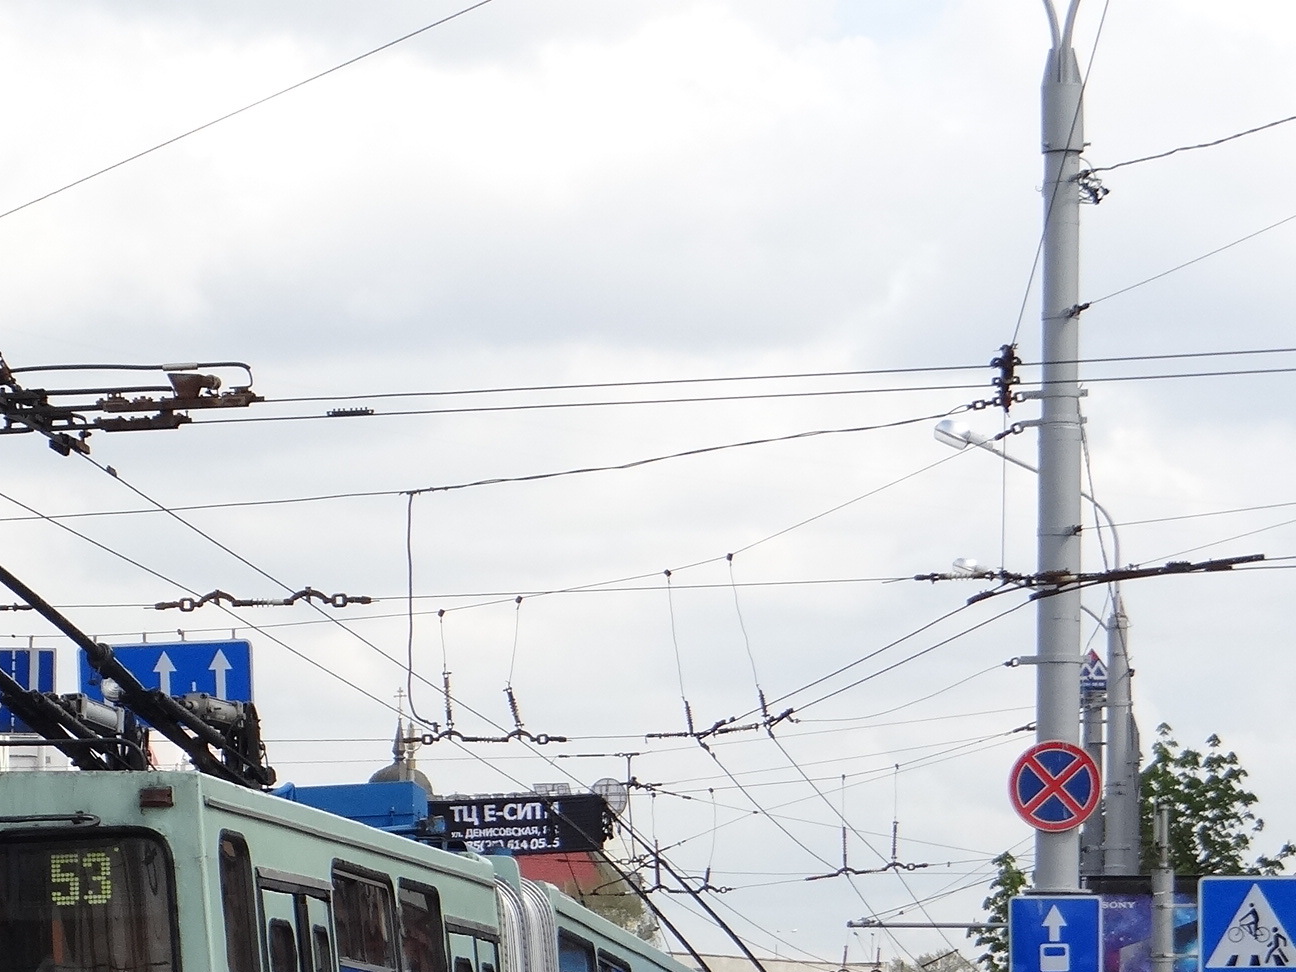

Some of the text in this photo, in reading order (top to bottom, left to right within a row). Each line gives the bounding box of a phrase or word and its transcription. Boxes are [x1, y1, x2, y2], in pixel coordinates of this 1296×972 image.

[449, 805, 479, 825] ТЦ
[51, 852, 112, 905] 53
[1102, 901, 1135, 909] SONY
